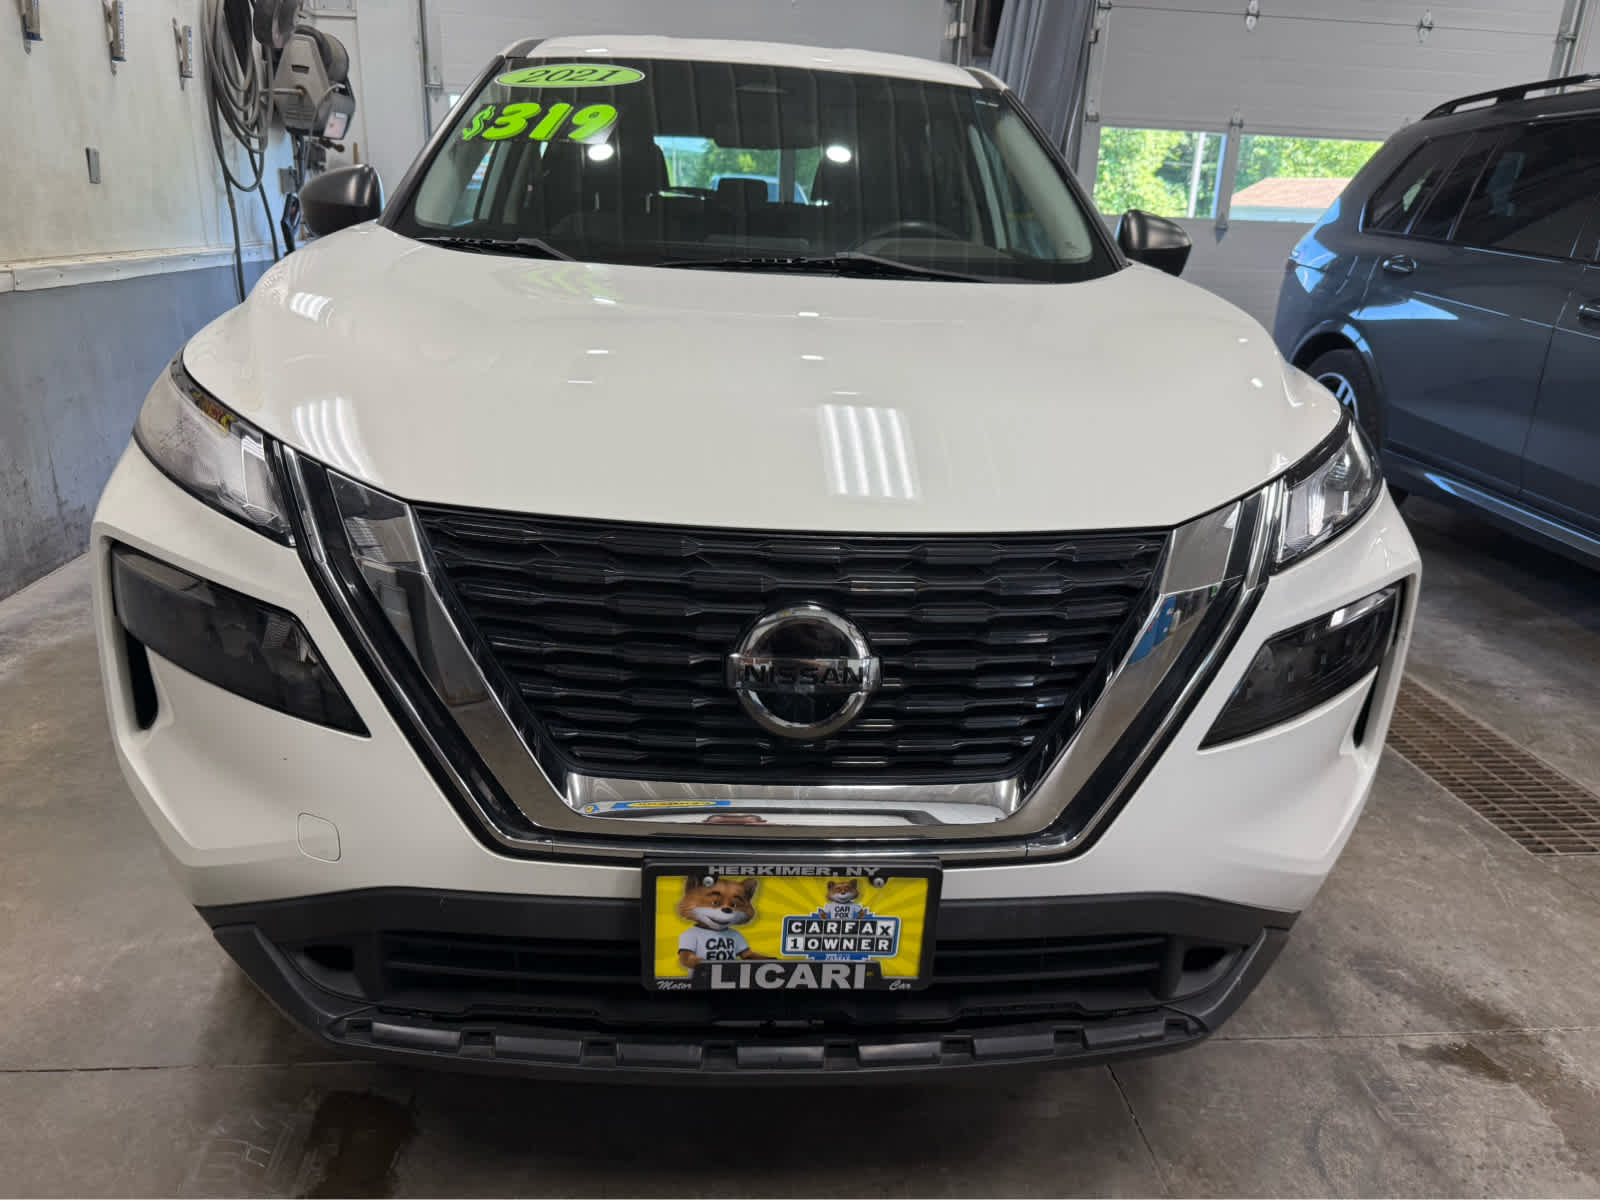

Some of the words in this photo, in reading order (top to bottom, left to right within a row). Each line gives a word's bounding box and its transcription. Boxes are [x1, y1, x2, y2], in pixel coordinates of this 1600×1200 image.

[517, 69, 620, 83] 2021
[462, 103, 618, 141] $319
[744, 665, 864, 684] NISSAN
[848, 866, 881, 876] NY
[791, 921, 891, 936] CARFAX
[705, 938, 735, 950] CAR
[790, 938, 800, 950] 1
[807, 938, 889, 951] OWNER
[706, 951, 735, 960] FOX
[711, 963, 866, 989] LICARI
[889, 979, 912, 991] Car
